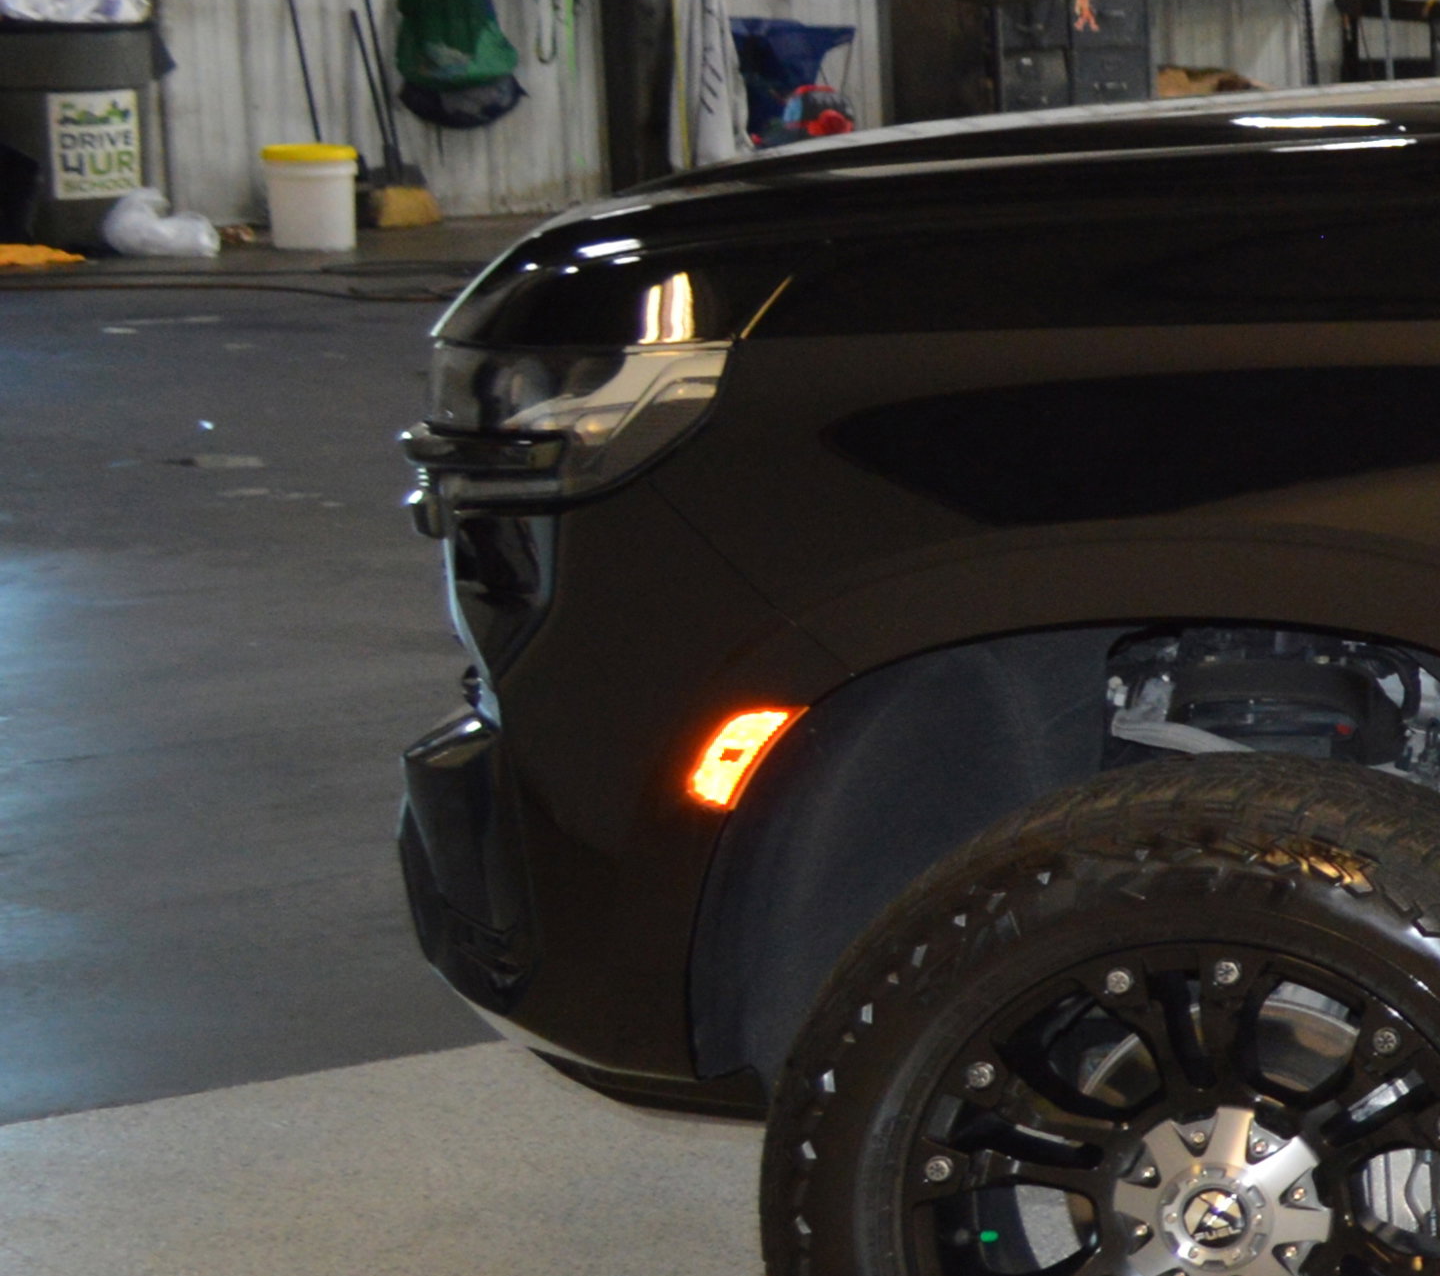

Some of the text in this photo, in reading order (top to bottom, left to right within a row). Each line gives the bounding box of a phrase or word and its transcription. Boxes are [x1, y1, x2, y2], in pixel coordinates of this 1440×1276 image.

[60, 130, 132, 149] DRIVE
[60, 150, 134, 176] 4UR
[1194, 1226, 1242, 1242] FUEL
